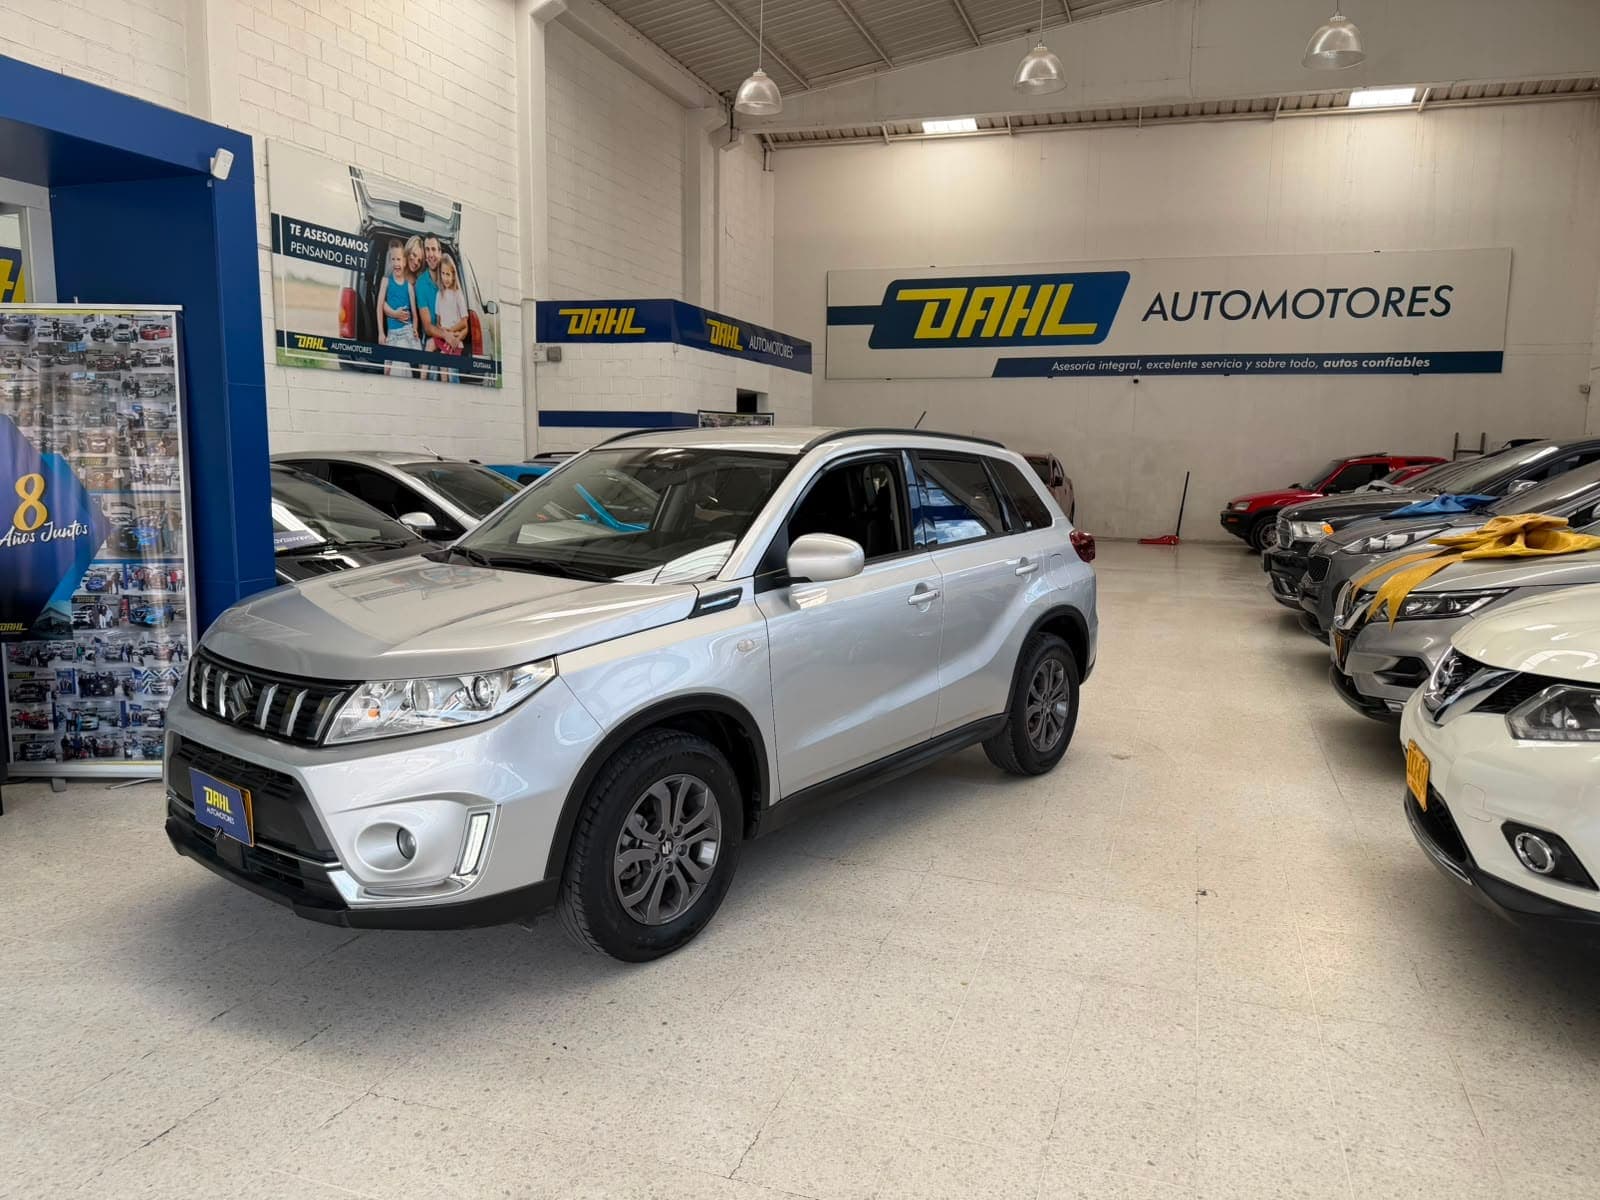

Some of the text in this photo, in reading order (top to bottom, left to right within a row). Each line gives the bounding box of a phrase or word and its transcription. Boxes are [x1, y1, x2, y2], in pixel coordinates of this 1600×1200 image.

[290, 223, 369, 253] TE ASESORAMOS
[290, 241, 368, 269] PENSANDO EN TI
[559, 308, 646, 335] DAHL
[896, 283, 1454, 339] DAHL AUTOMOTORES
[294, 334, 373, 354] DAHL AUTOMOTORES
[706, 319, 794, 360] DAHL AUTOMOTORES
[1051, 356, 1431, 373] Asesoría integral, excelente servicio y sobre todo, autos confiables
[13, 473, 48, 531] 8
[0, 519, 88, 548] Años Juntos
[203, 786, 233, 814] DAHL
